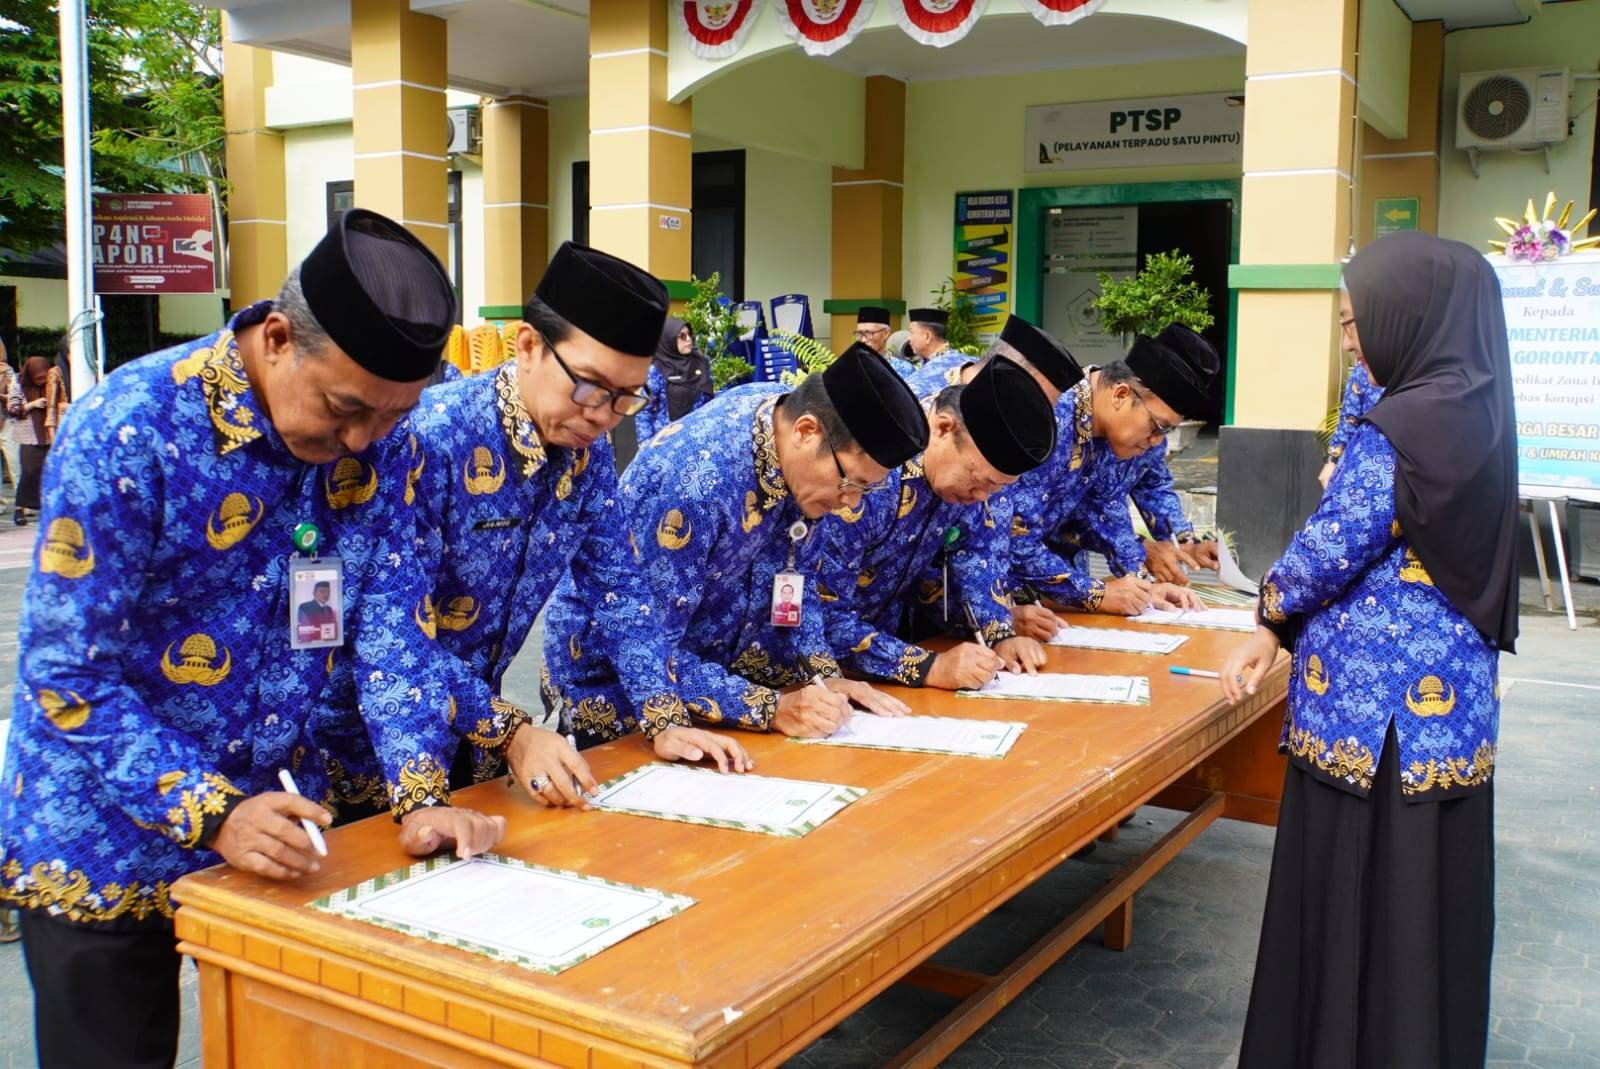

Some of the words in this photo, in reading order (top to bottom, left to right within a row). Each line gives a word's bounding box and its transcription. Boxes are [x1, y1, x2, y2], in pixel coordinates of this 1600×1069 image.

[1109, 107, 1182, 134] PTSP
[1053, 139, 1120, 154] (PELAYANAN
[1122, 136, 1170, 149] TERPADU
[1172, 134, 1201, 146] SATU
[1202, 131, 1241, 145] PINTU)
[1548, 277, 1569, 298] &
[1523, 305, 1575, 319] Kepada
[1507, 328, 1599, 341] MENTERIA
[1557, 375, 1588, 385] Zona
[1545, 393, 1595, 406] Korupsi
[1545, 422, 1599, 439] BESAR
[1540, 447, 1587, 462] UMRAH
